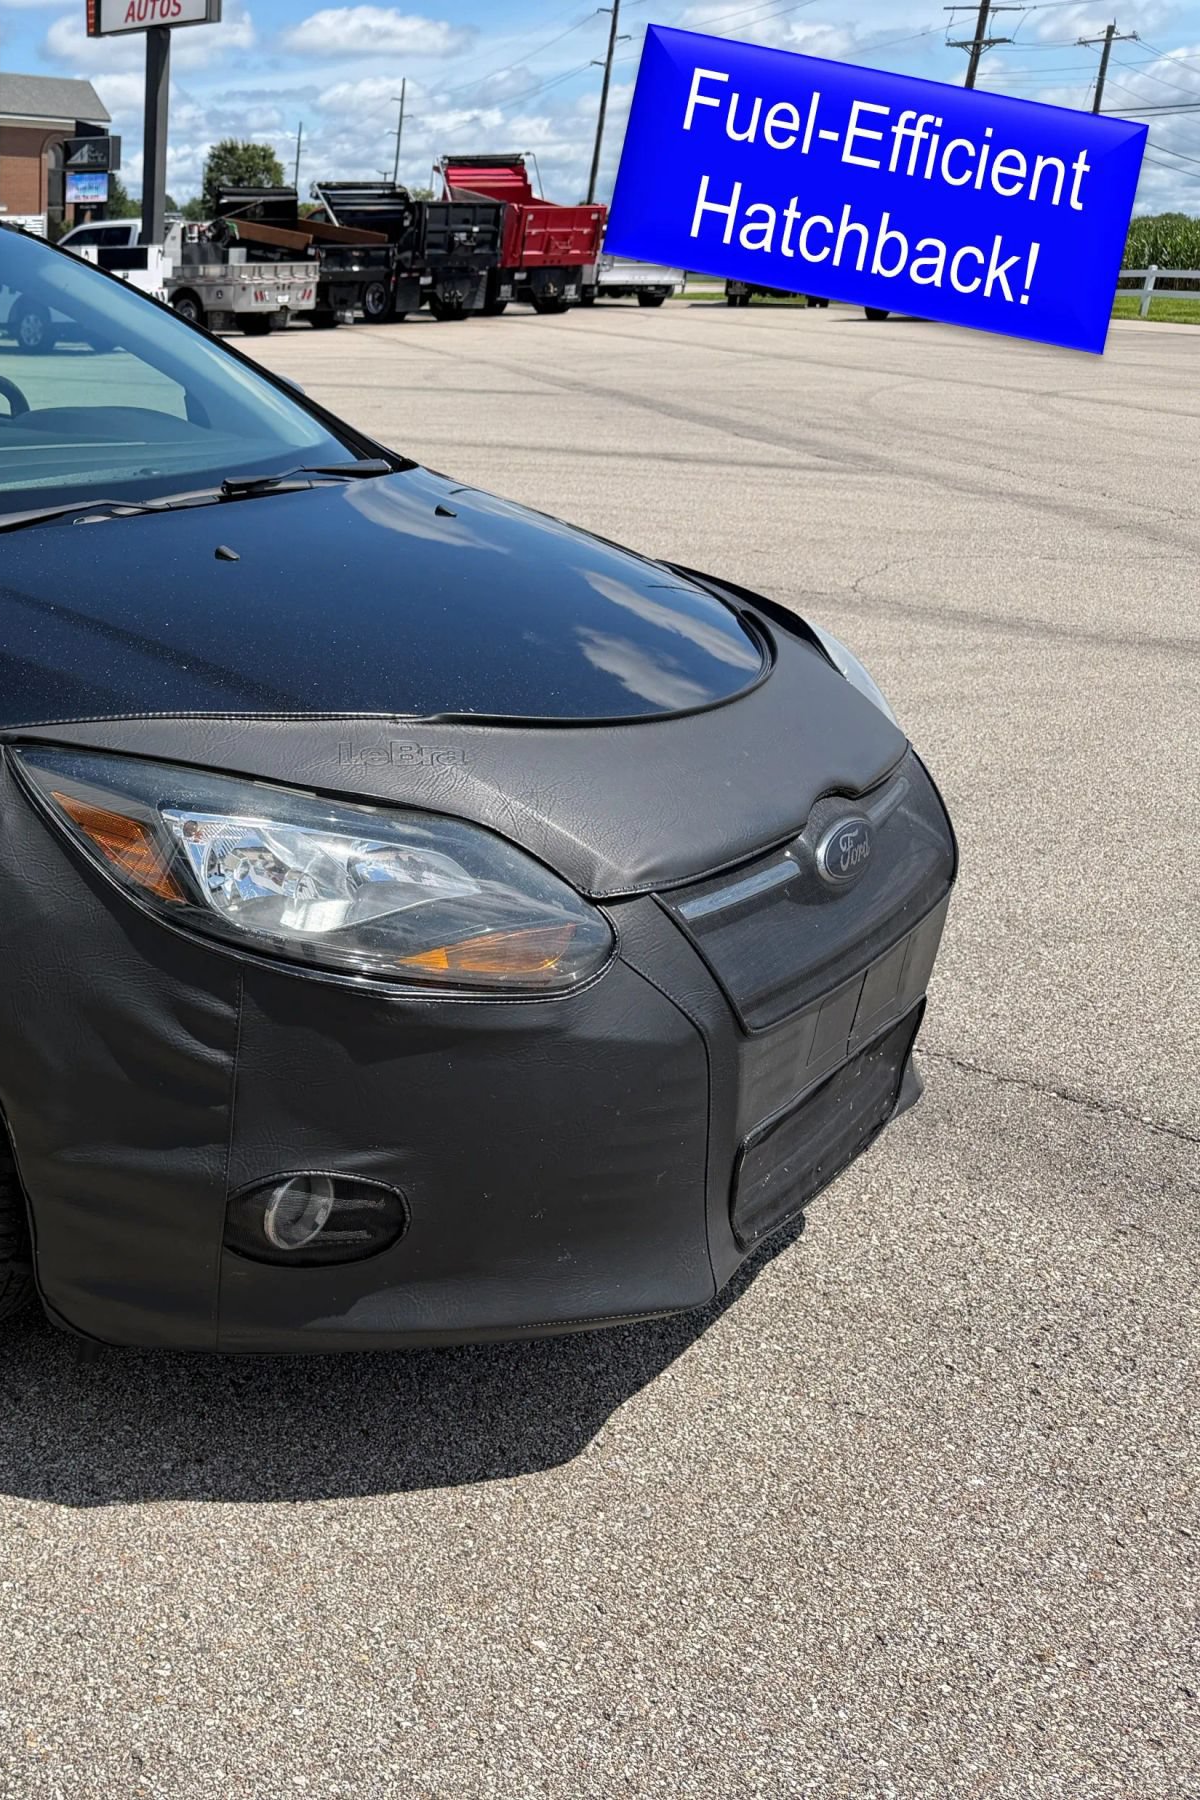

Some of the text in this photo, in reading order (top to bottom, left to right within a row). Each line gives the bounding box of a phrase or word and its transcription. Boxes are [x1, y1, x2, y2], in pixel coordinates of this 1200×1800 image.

[124, 0, 182, 23] AUTOS
[339, 740, 467, 766] LeBra
[840, 829, 871, 871] Ford
